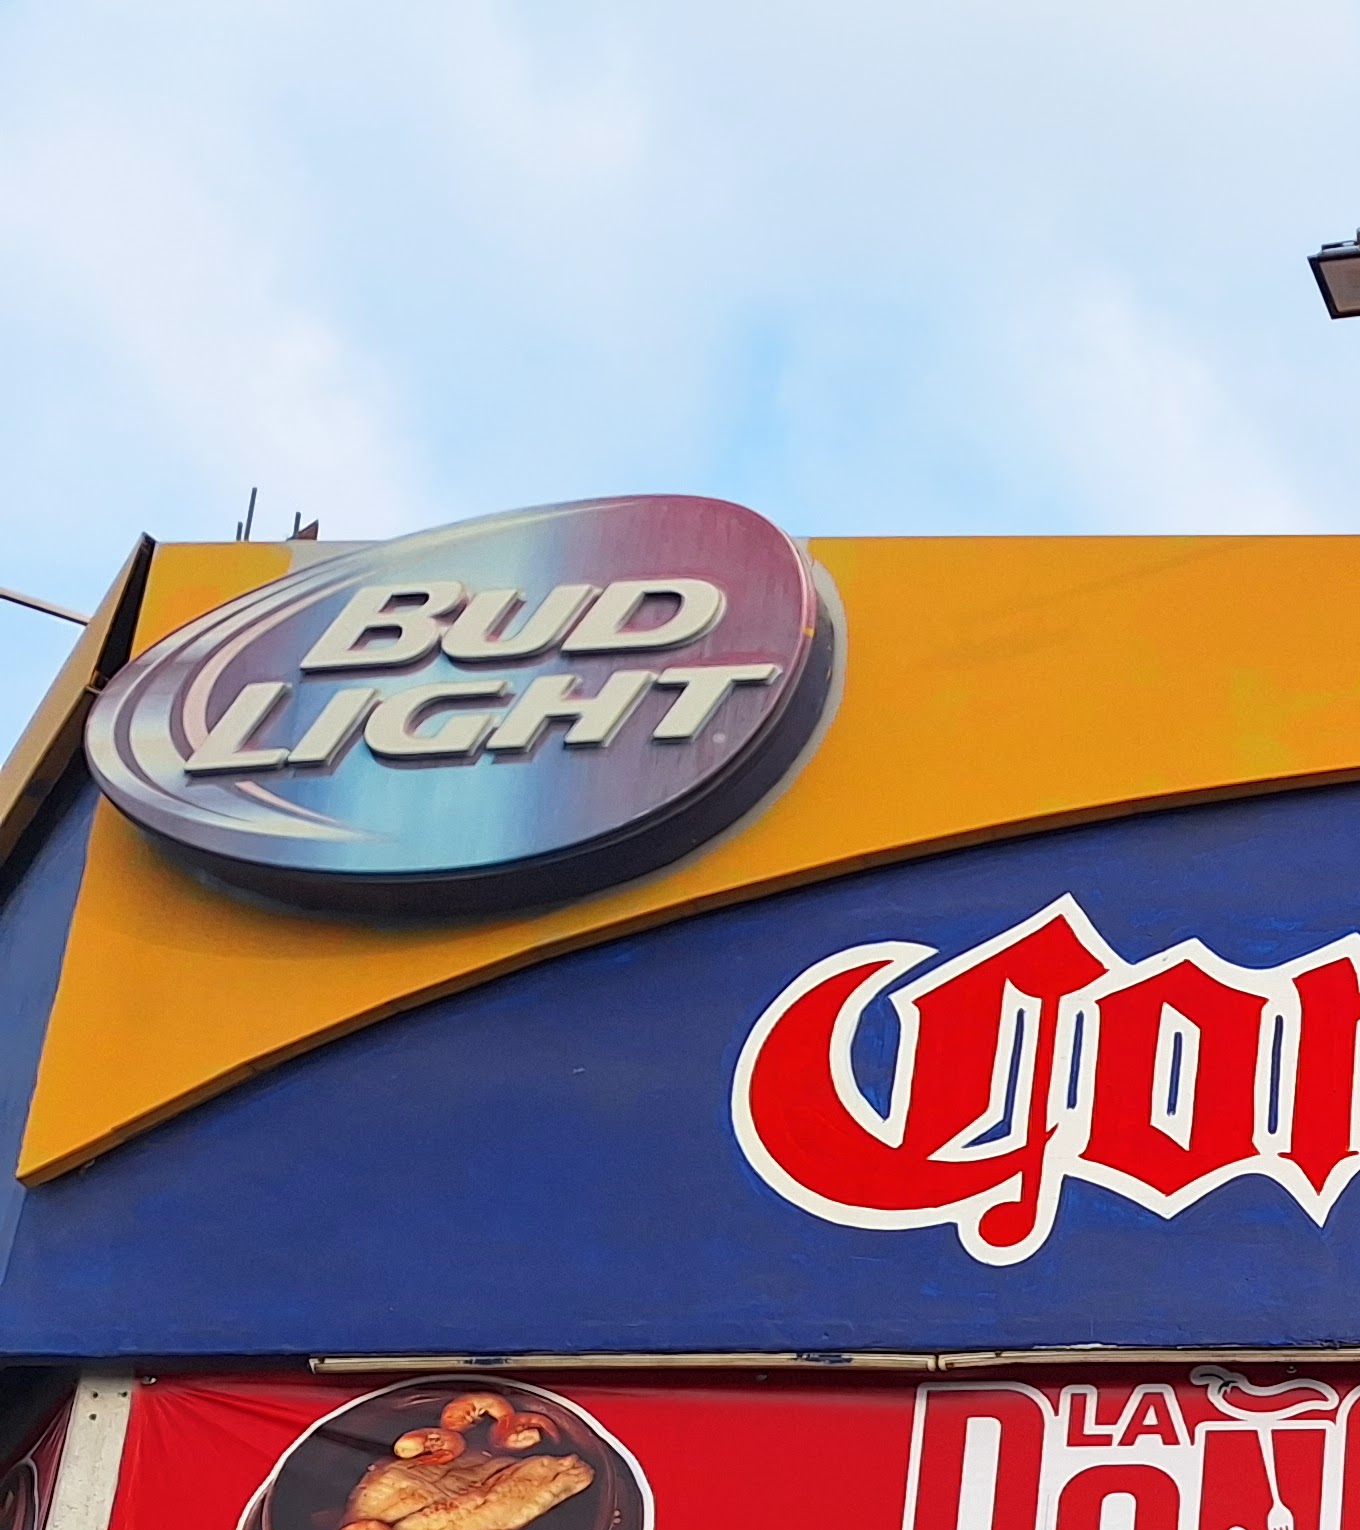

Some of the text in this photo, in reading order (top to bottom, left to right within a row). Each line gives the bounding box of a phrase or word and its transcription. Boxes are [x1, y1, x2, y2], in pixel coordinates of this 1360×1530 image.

[301, 578, 726, 672] BUD
[184, 664, 783, 775] LIGHT
[1064, 1388, 1184, 1447] LA
